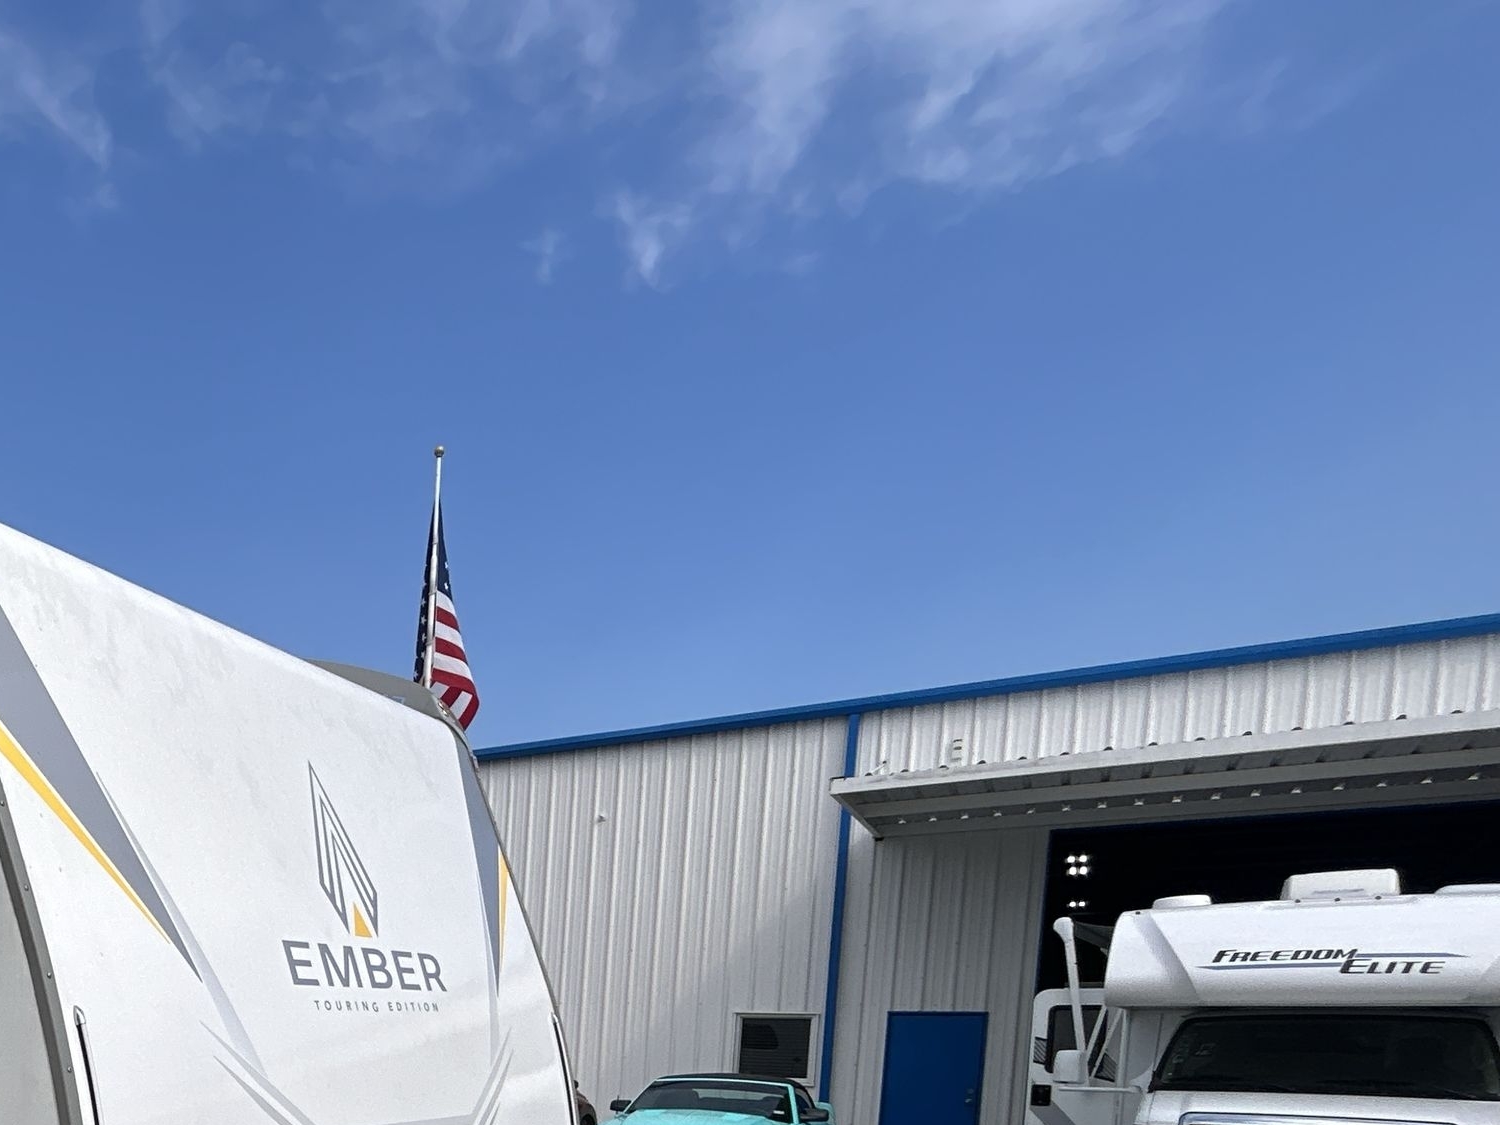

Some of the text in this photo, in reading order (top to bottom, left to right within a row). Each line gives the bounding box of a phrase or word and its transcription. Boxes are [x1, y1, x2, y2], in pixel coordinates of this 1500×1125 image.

[1212, 948, 1358, 964] FREEDOM
[282, 939, 448, 992] EMBER
[1340, 958, 1446, 974] ELITE
[314, 999, 440, 1012] TOURING EDITION
